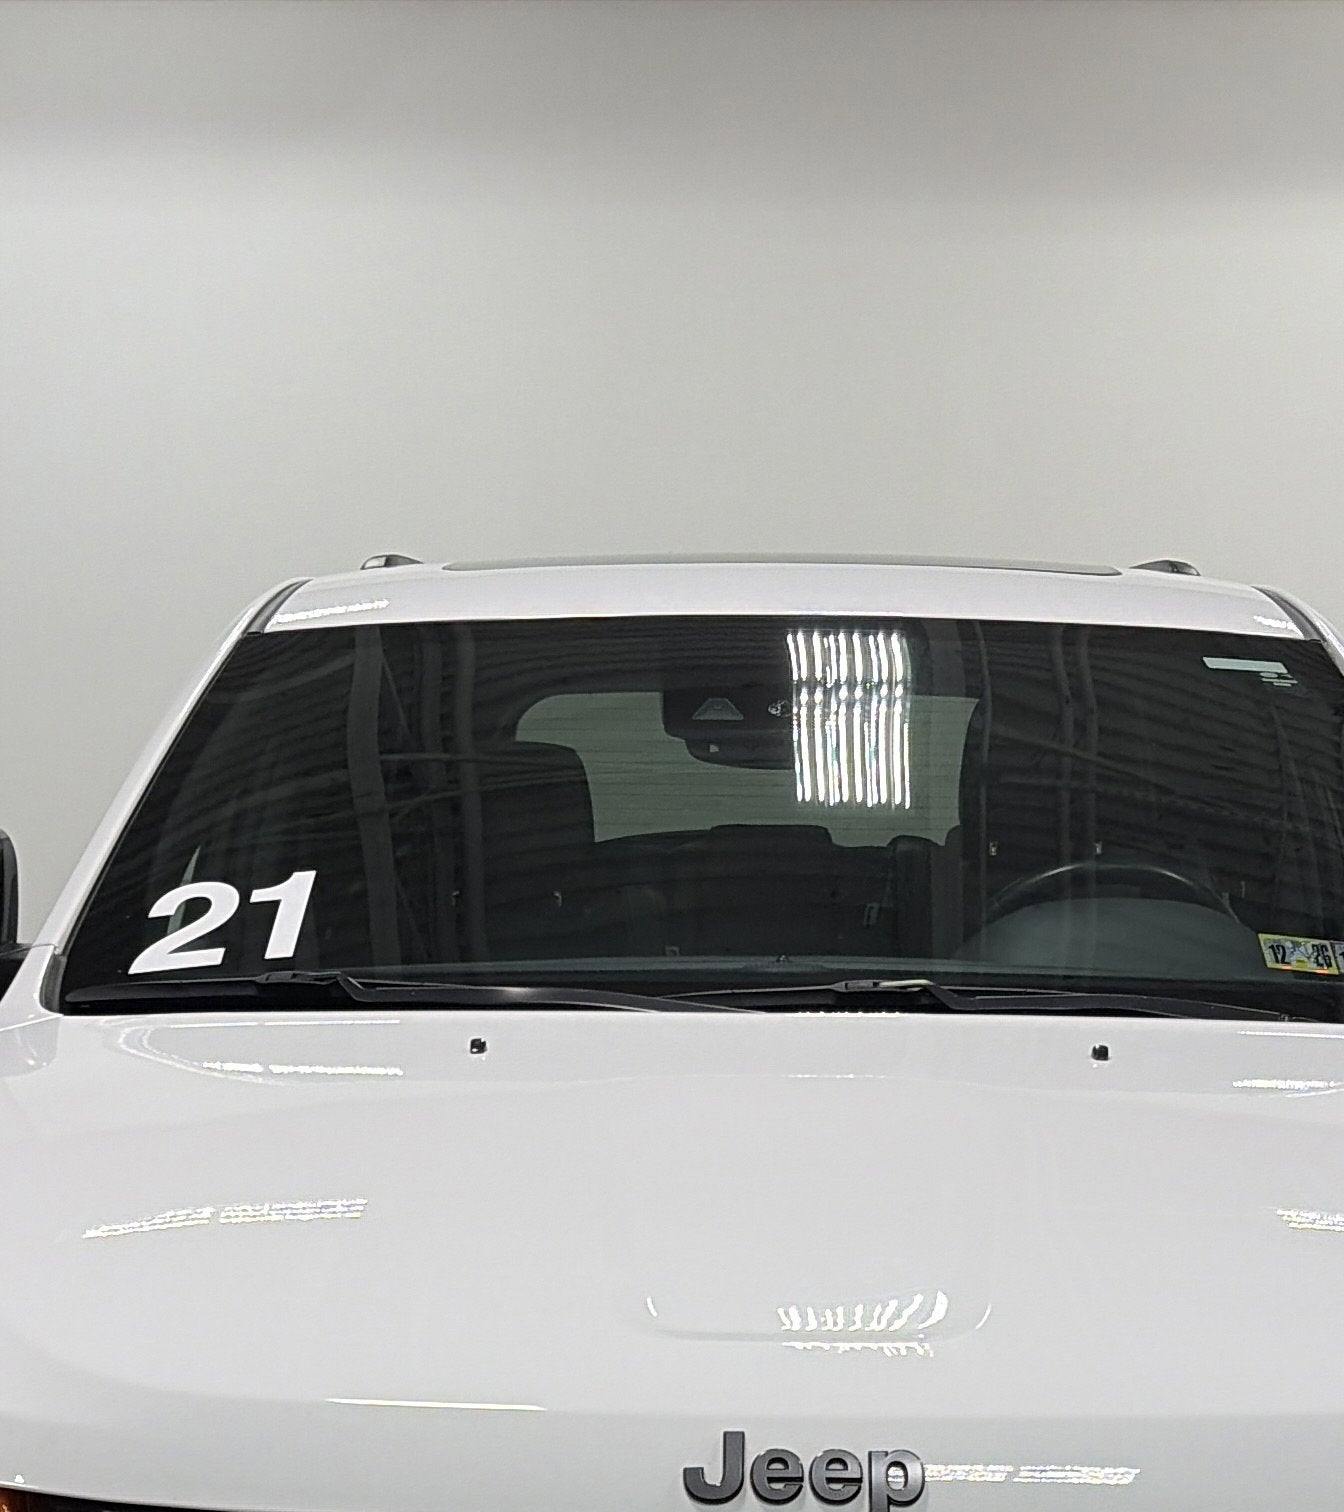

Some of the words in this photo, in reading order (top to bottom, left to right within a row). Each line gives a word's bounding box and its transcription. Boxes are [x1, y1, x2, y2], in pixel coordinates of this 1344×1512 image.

[127, 870, 317, 975] 21
[1268, 944, 1291, 965] 12
[1311, 943, 1333, 969] 26
